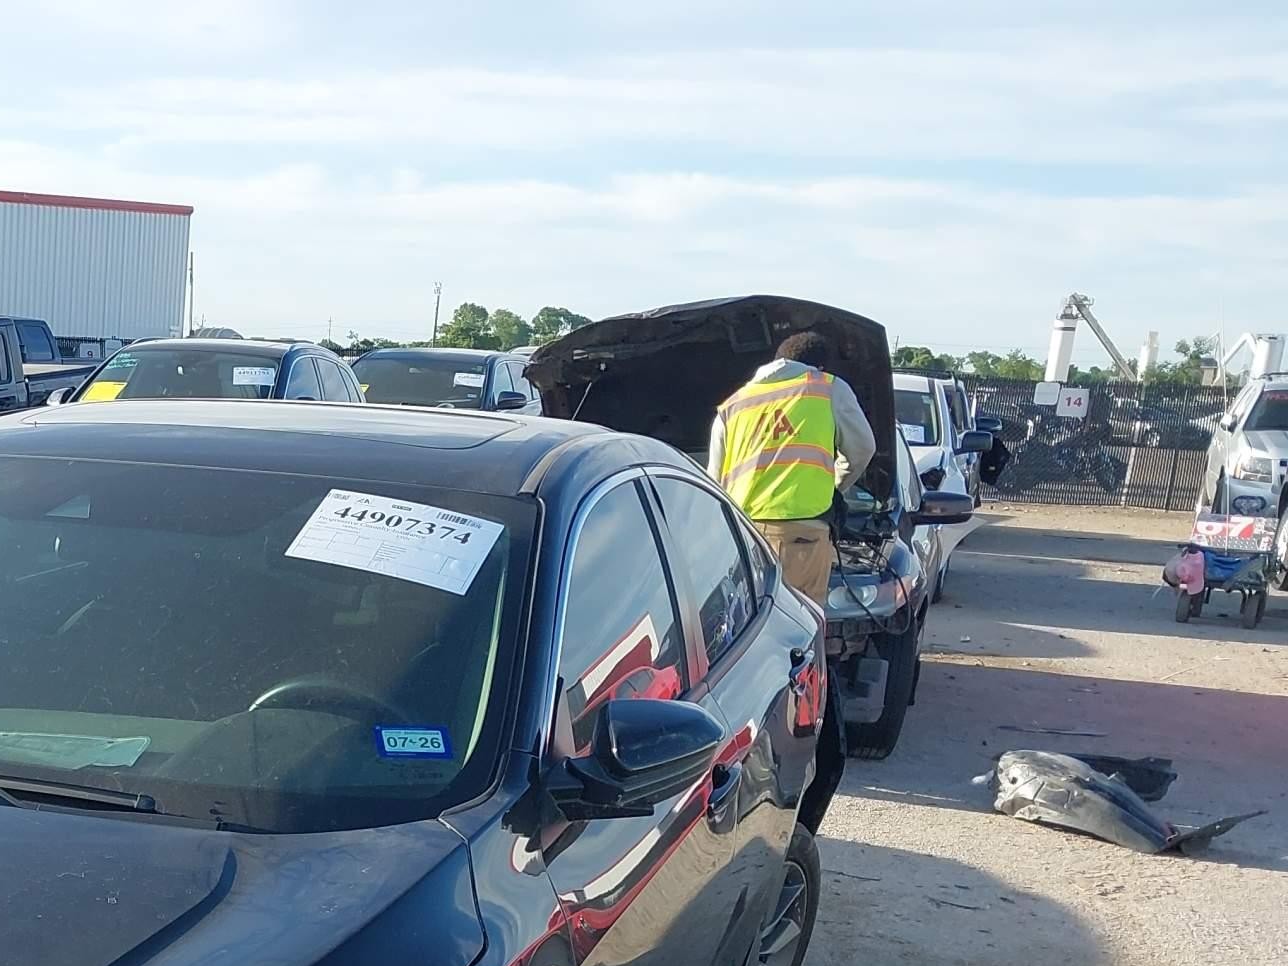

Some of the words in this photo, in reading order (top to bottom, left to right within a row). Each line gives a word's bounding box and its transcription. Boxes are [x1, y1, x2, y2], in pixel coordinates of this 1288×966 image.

[1065, 396, 1082, 408] 14
[334, 505, 472, 545] 44907374
[386, 736, 441, 749] 07-26
